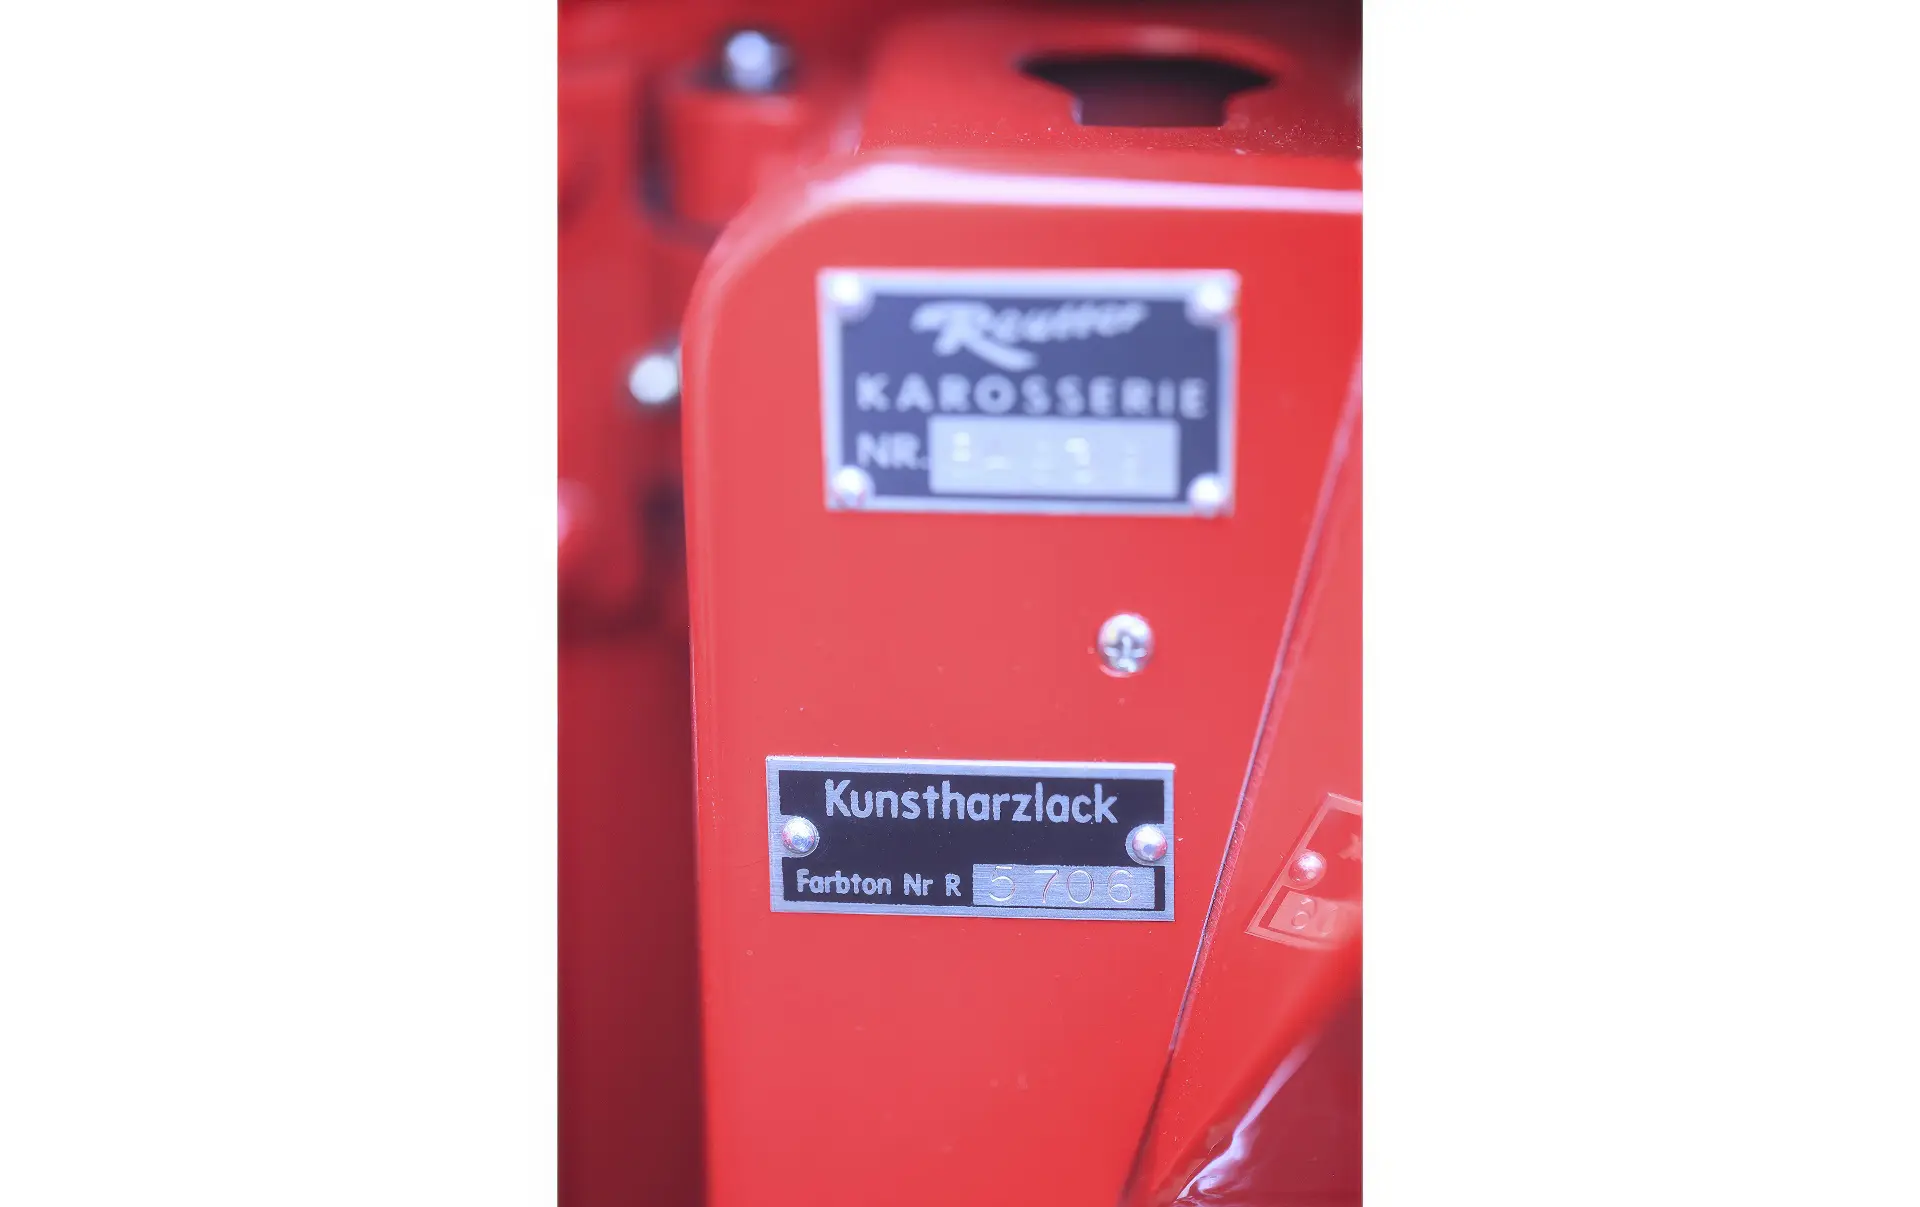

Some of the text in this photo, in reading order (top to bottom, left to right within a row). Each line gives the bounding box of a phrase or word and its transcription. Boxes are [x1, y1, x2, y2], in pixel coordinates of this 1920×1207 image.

[855, 372, 1208, 419] KAROSSERIE
[824, 779, 1118, 824] Kunstharzlack
[796, 865, 1134, 904] Farbton Nr R 5706
